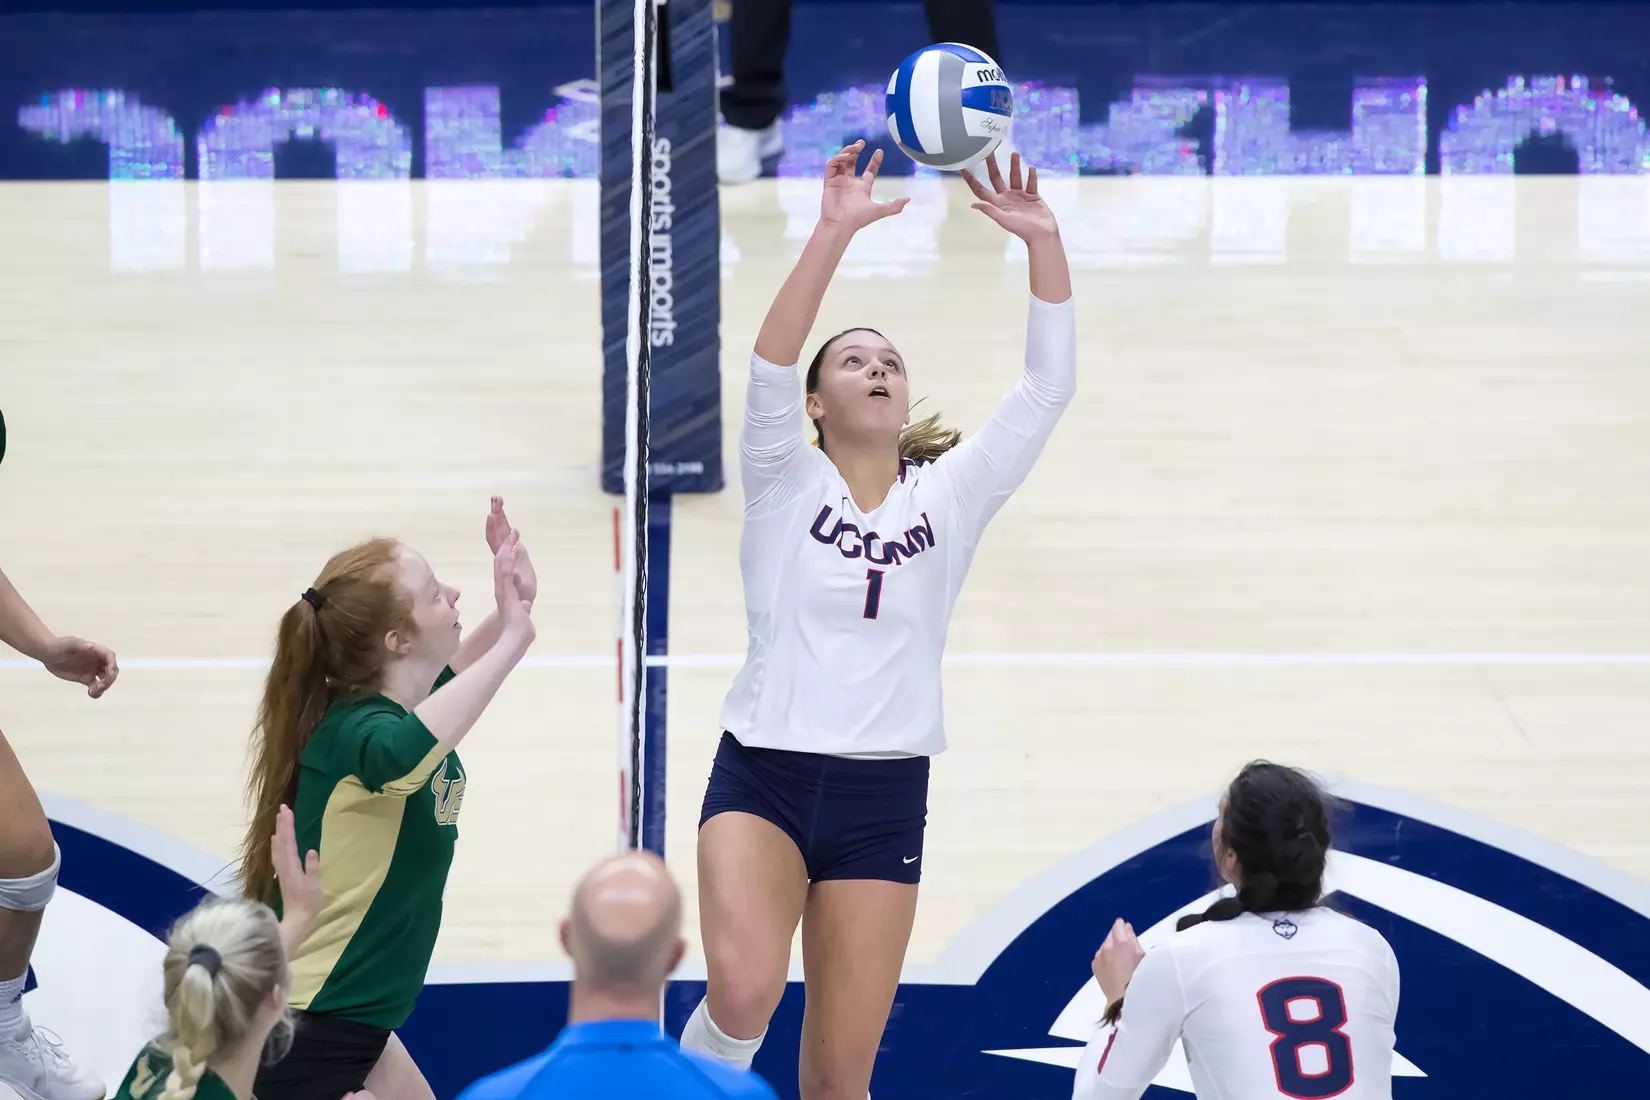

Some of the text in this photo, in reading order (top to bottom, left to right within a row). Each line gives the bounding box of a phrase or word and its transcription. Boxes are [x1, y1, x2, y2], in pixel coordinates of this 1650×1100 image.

[650, 137, 675, 230] sports
[809, 504, 936, 566] UCONN
[863, 568, 886, 620] 1
[1256, 976, 1354, 1100] 8
